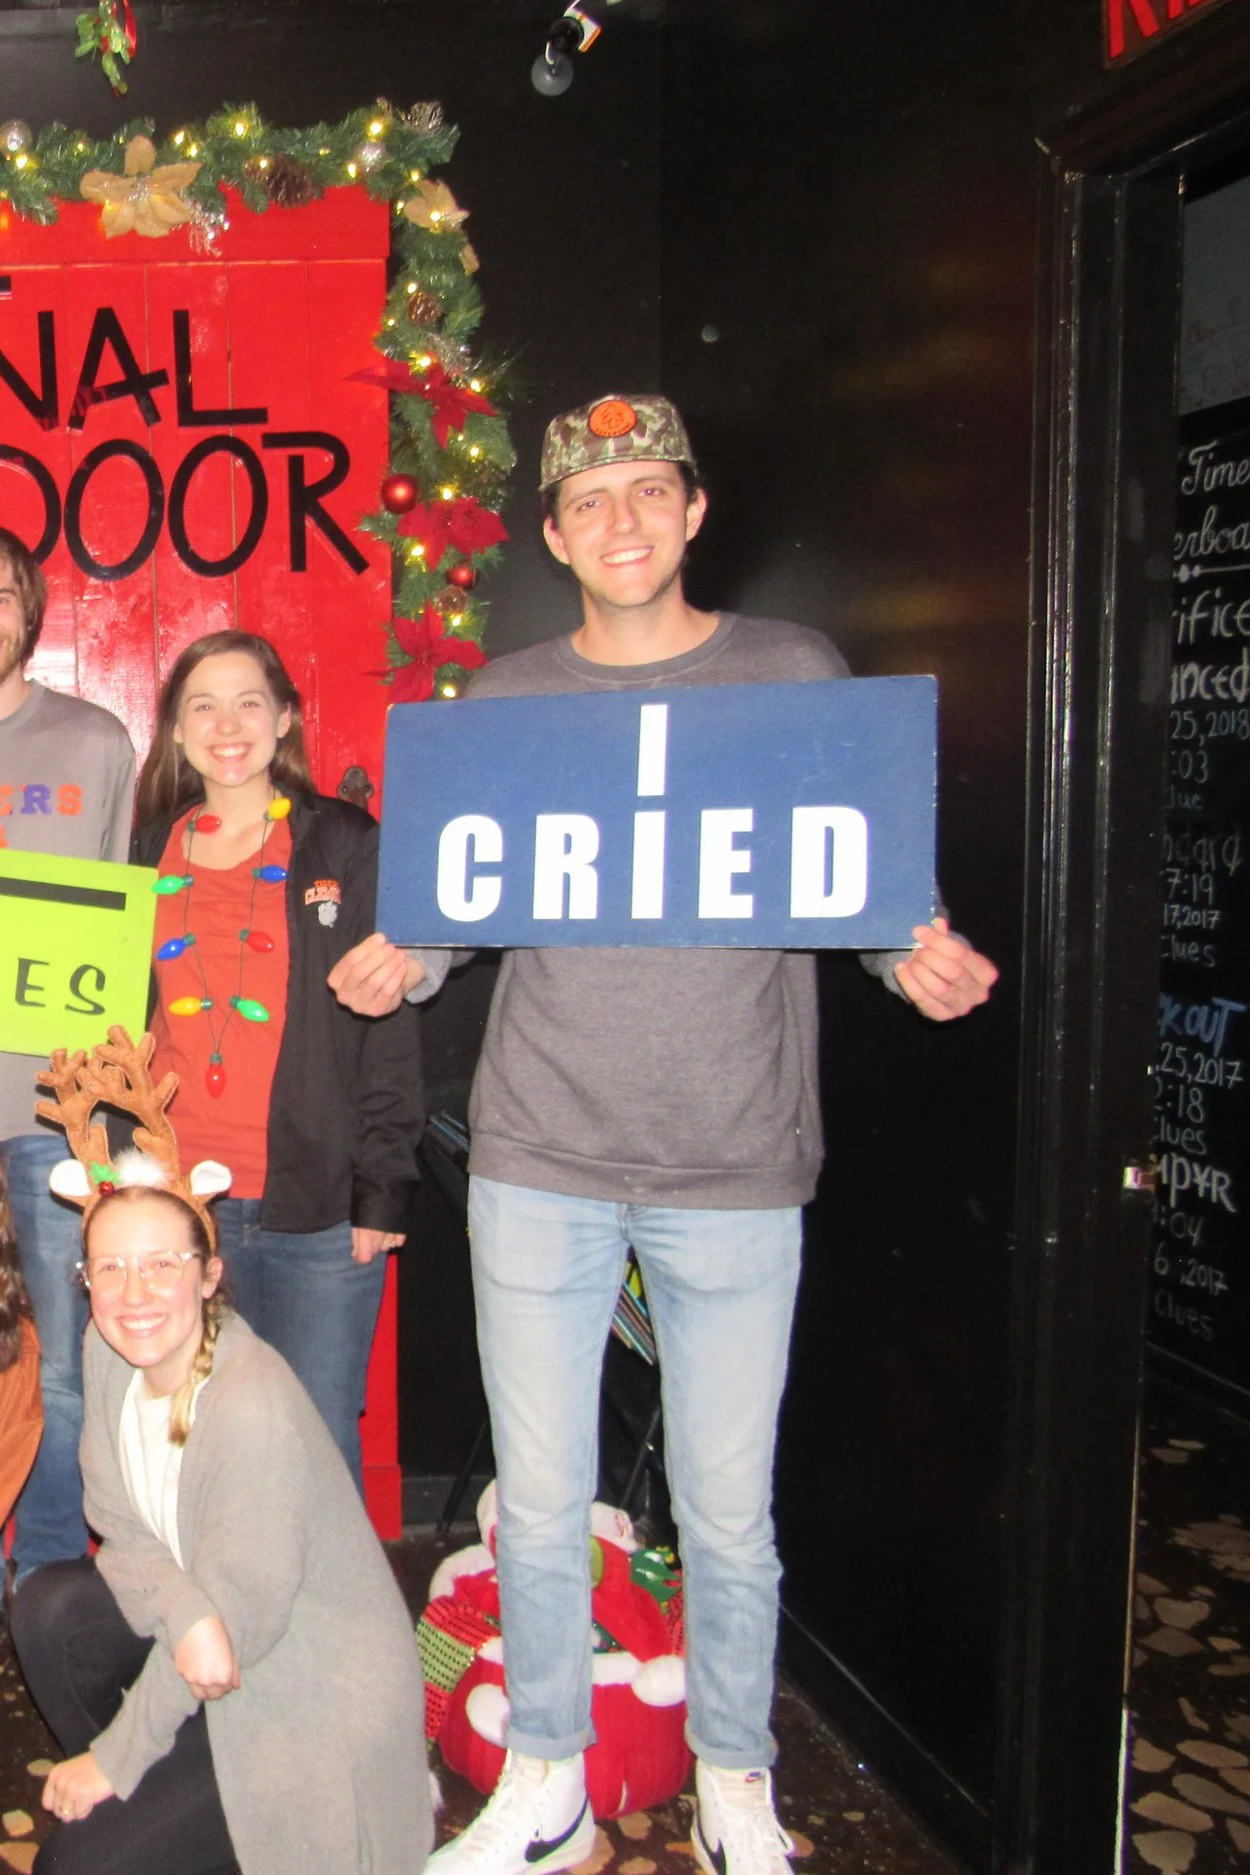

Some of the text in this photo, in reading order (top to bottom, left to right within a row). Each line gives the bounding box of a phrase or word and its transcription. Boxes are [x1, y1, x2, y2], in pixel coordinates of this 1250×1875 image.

[1172, 587, 1250, 644] ifice
[637, 703, 669, 796] I
[437, 806, 868, 922] CRIED
